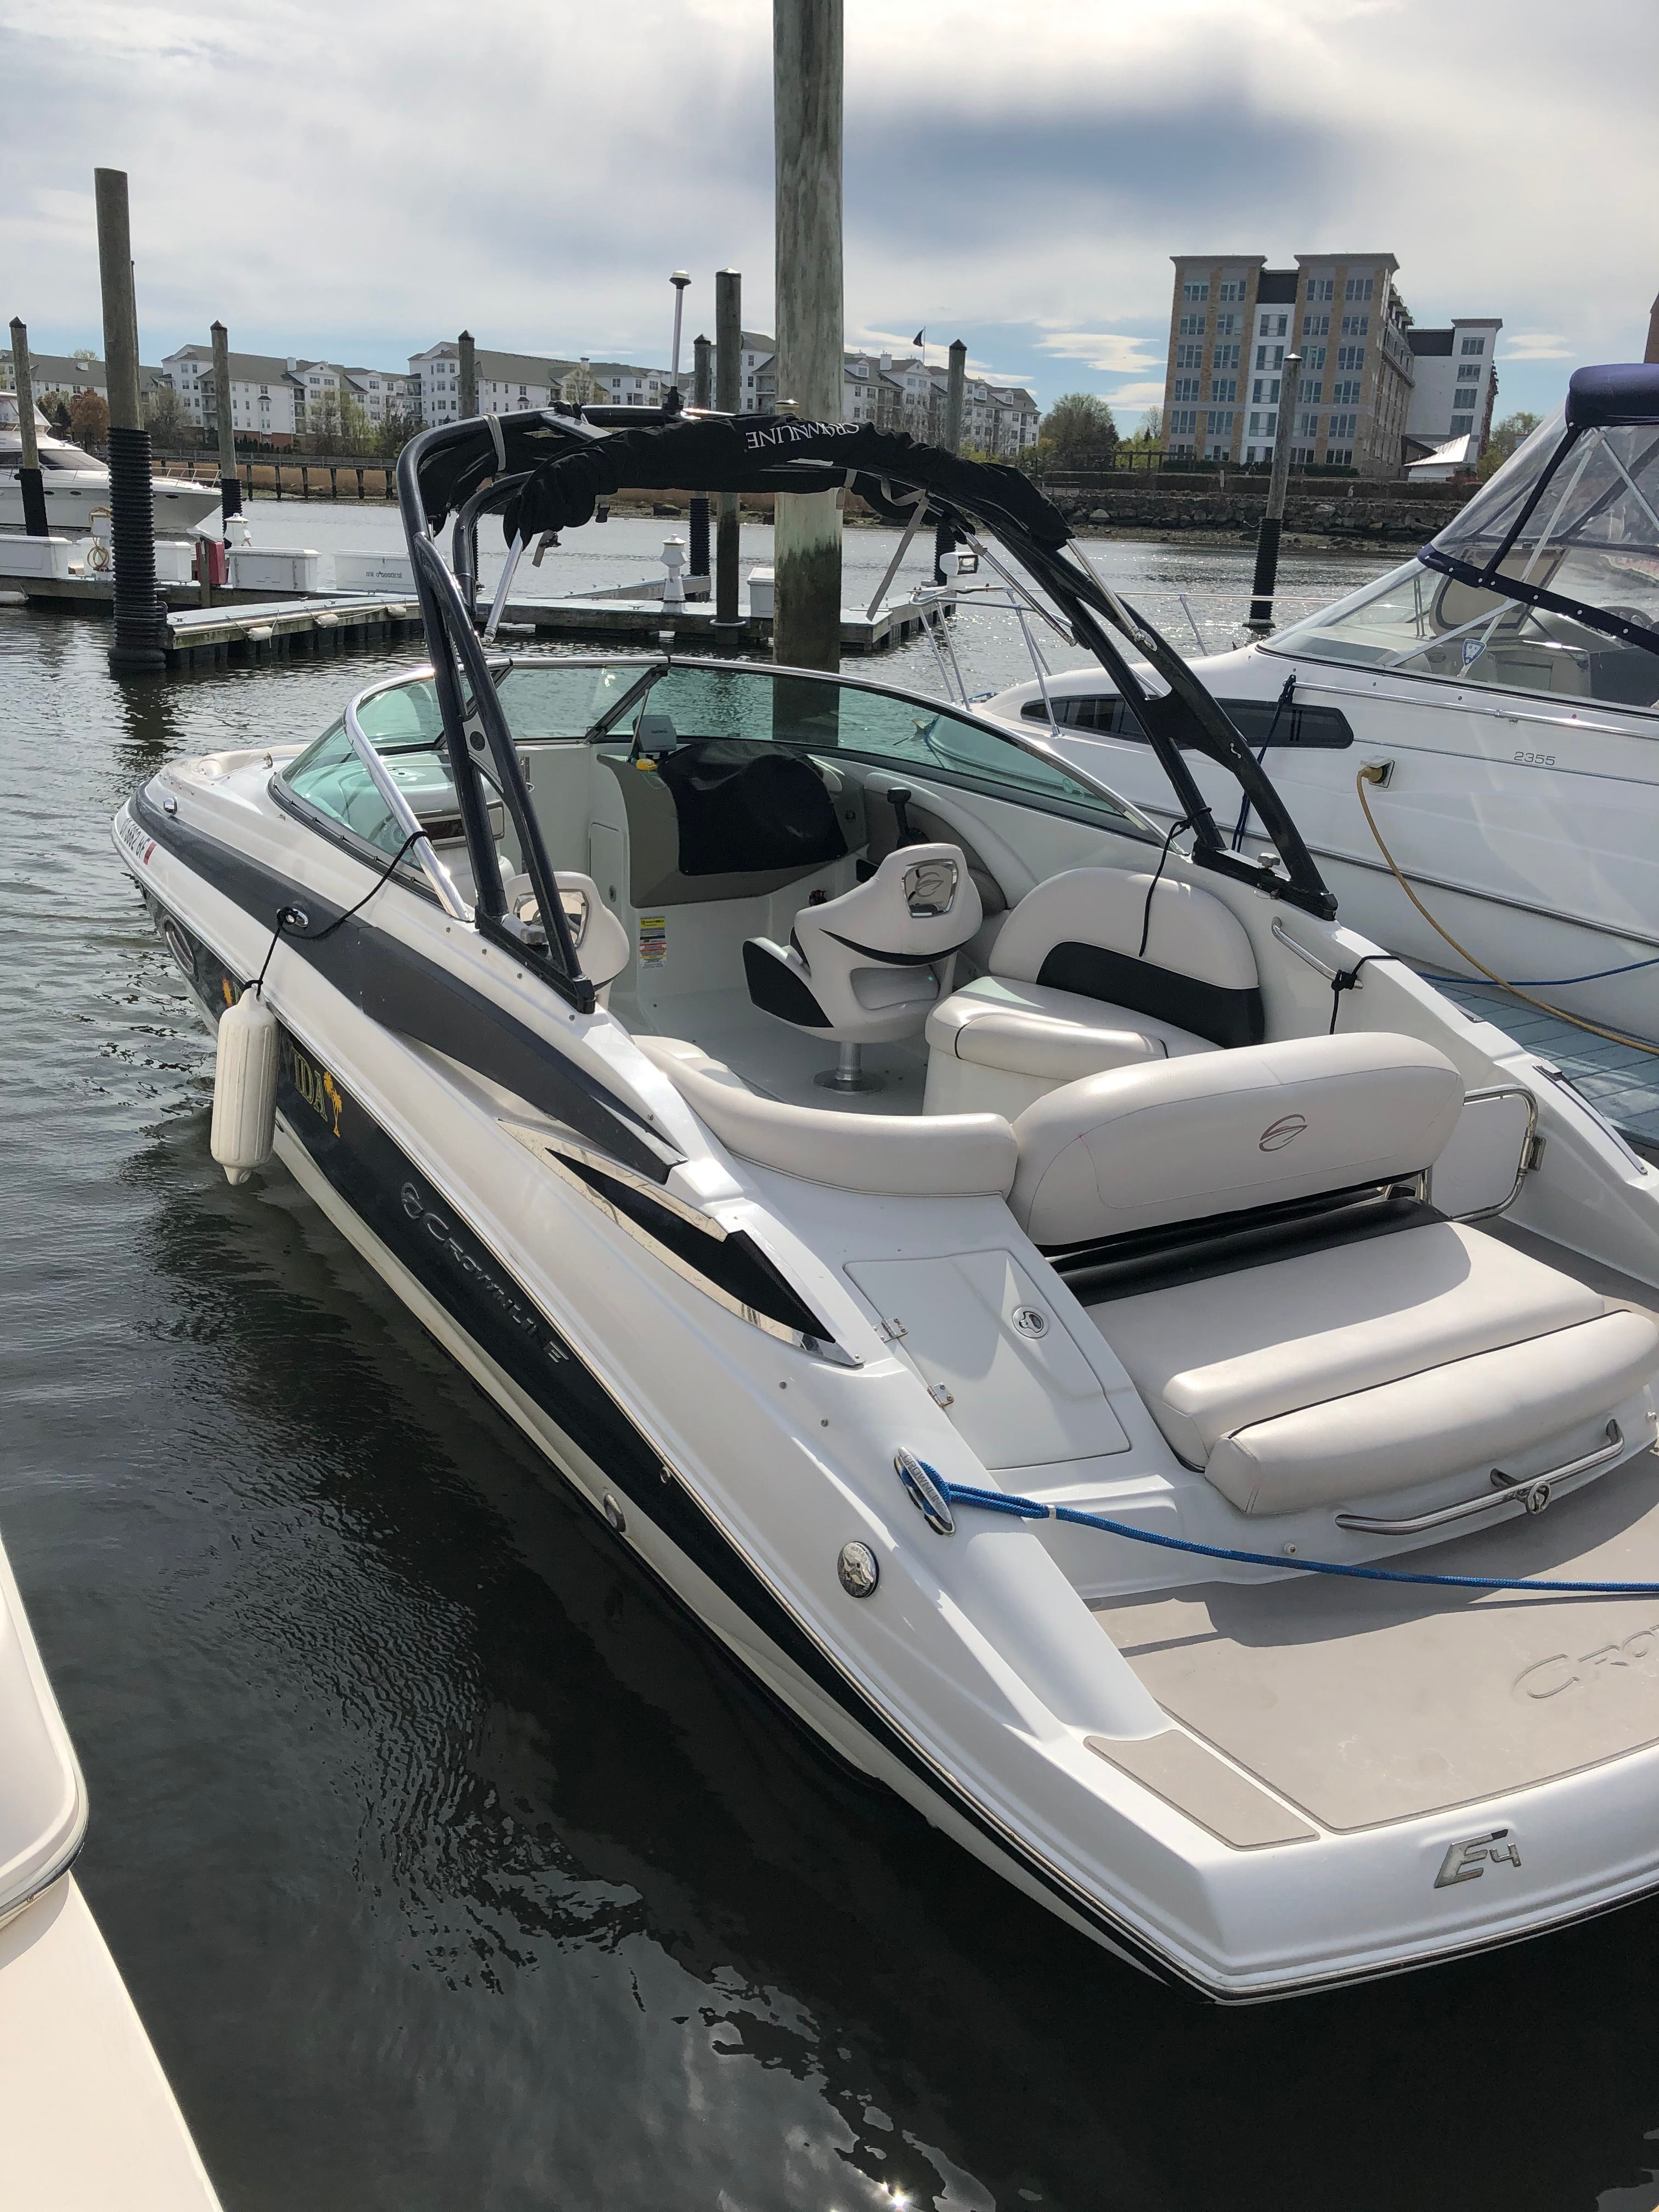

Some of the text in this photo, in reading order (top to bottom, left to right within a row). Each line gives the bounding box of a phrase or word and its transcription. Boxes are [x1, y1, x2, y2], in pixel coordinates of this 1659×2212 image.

[746, 422, 860, 449] CROWNLINE
[1514, 751, 1556, 766] 2355
[1434, 1829, 1522, 1889] E4
